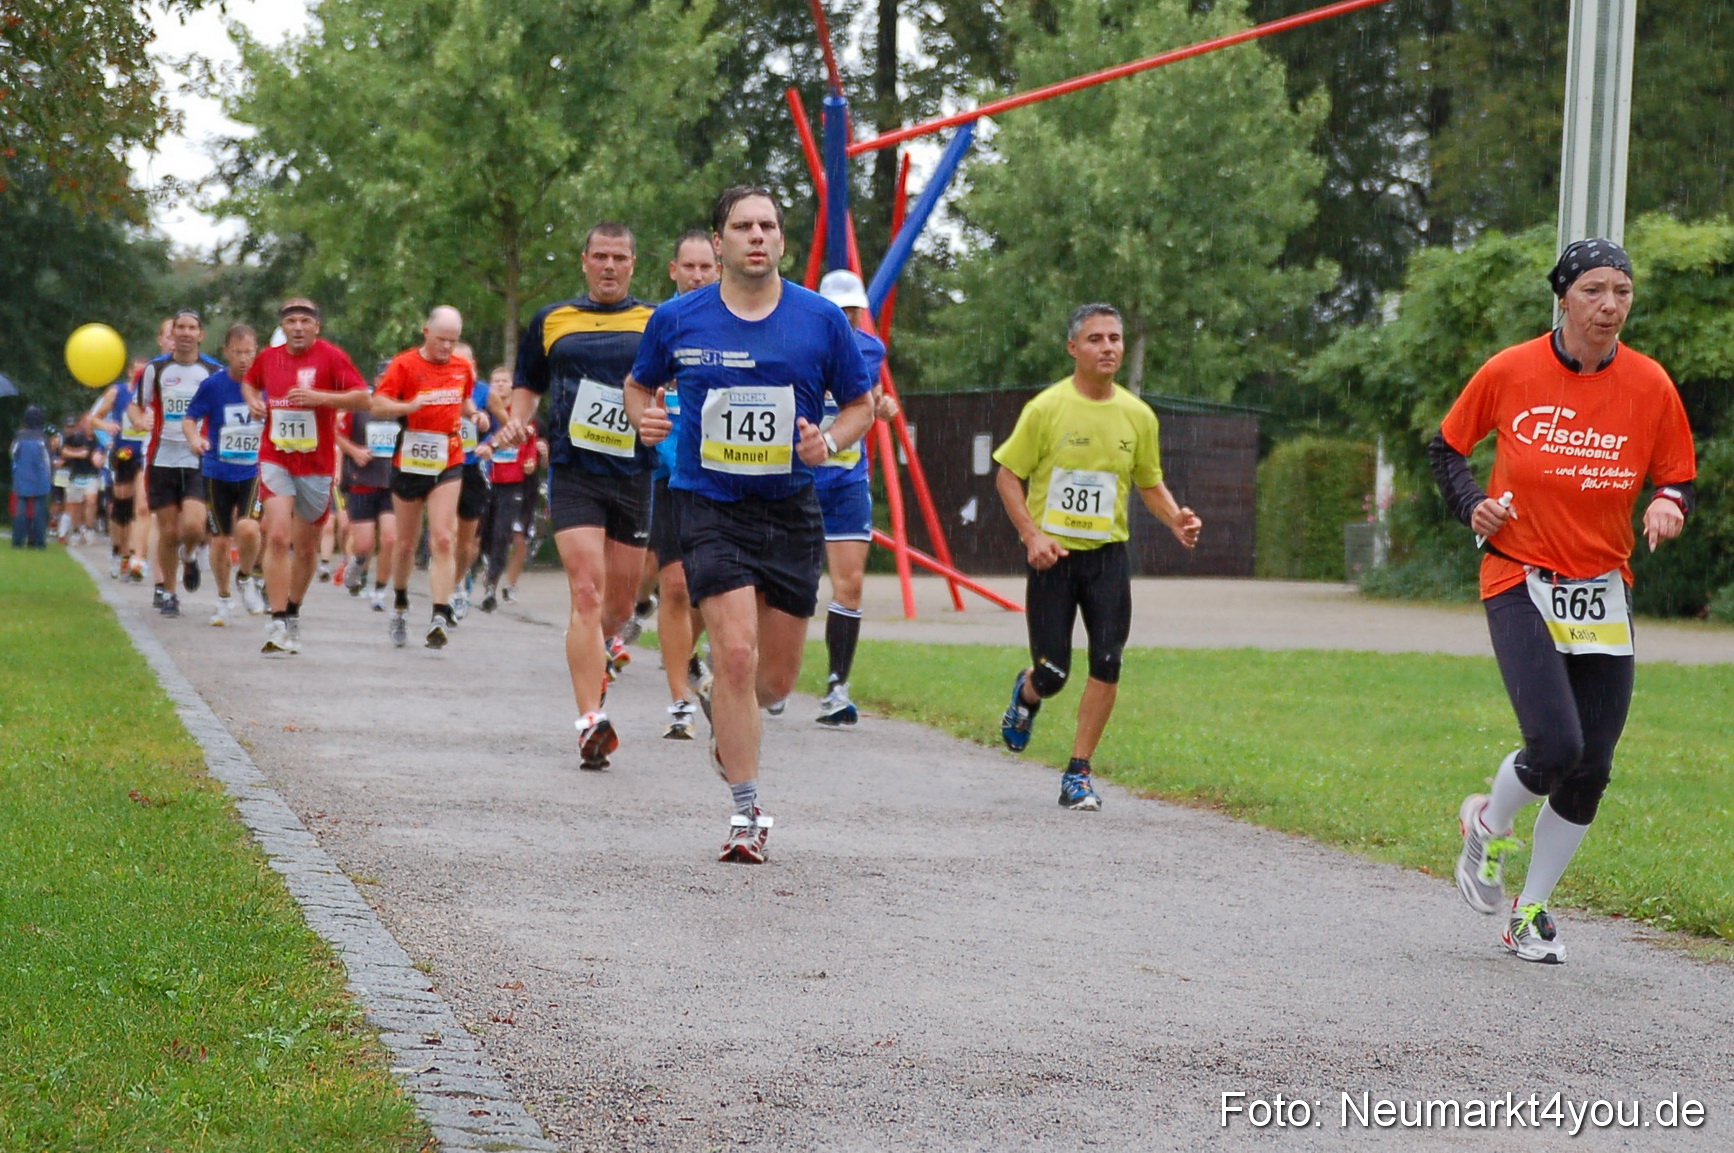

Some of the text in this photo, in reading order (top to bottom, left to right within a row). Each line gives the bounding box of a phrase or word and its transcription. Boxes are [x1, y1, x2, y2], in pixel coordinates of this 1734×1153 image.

[587, 402, 629, 432] 249
[279, 422, 306, 438] 311
[721, 410, 776, 442] 143
[1532, 419, 1628, 450] Fischer
[225, 435, 259, 451] 2462
[583, 430, 622, 446] Joachim
[411, 443, 439, 460] 655
[724, 448, 769, 462] Manuel
[1540, 443, 1620, 461] AUTOMOBILE
[1555, 465, 1577, 477] und
[1578, 464, 1599, 477] das
[1062, 487, 1101, 513] 381
[1552, 586, 1607, 621] 665
[1569, 627, 1598, 643] Katja
